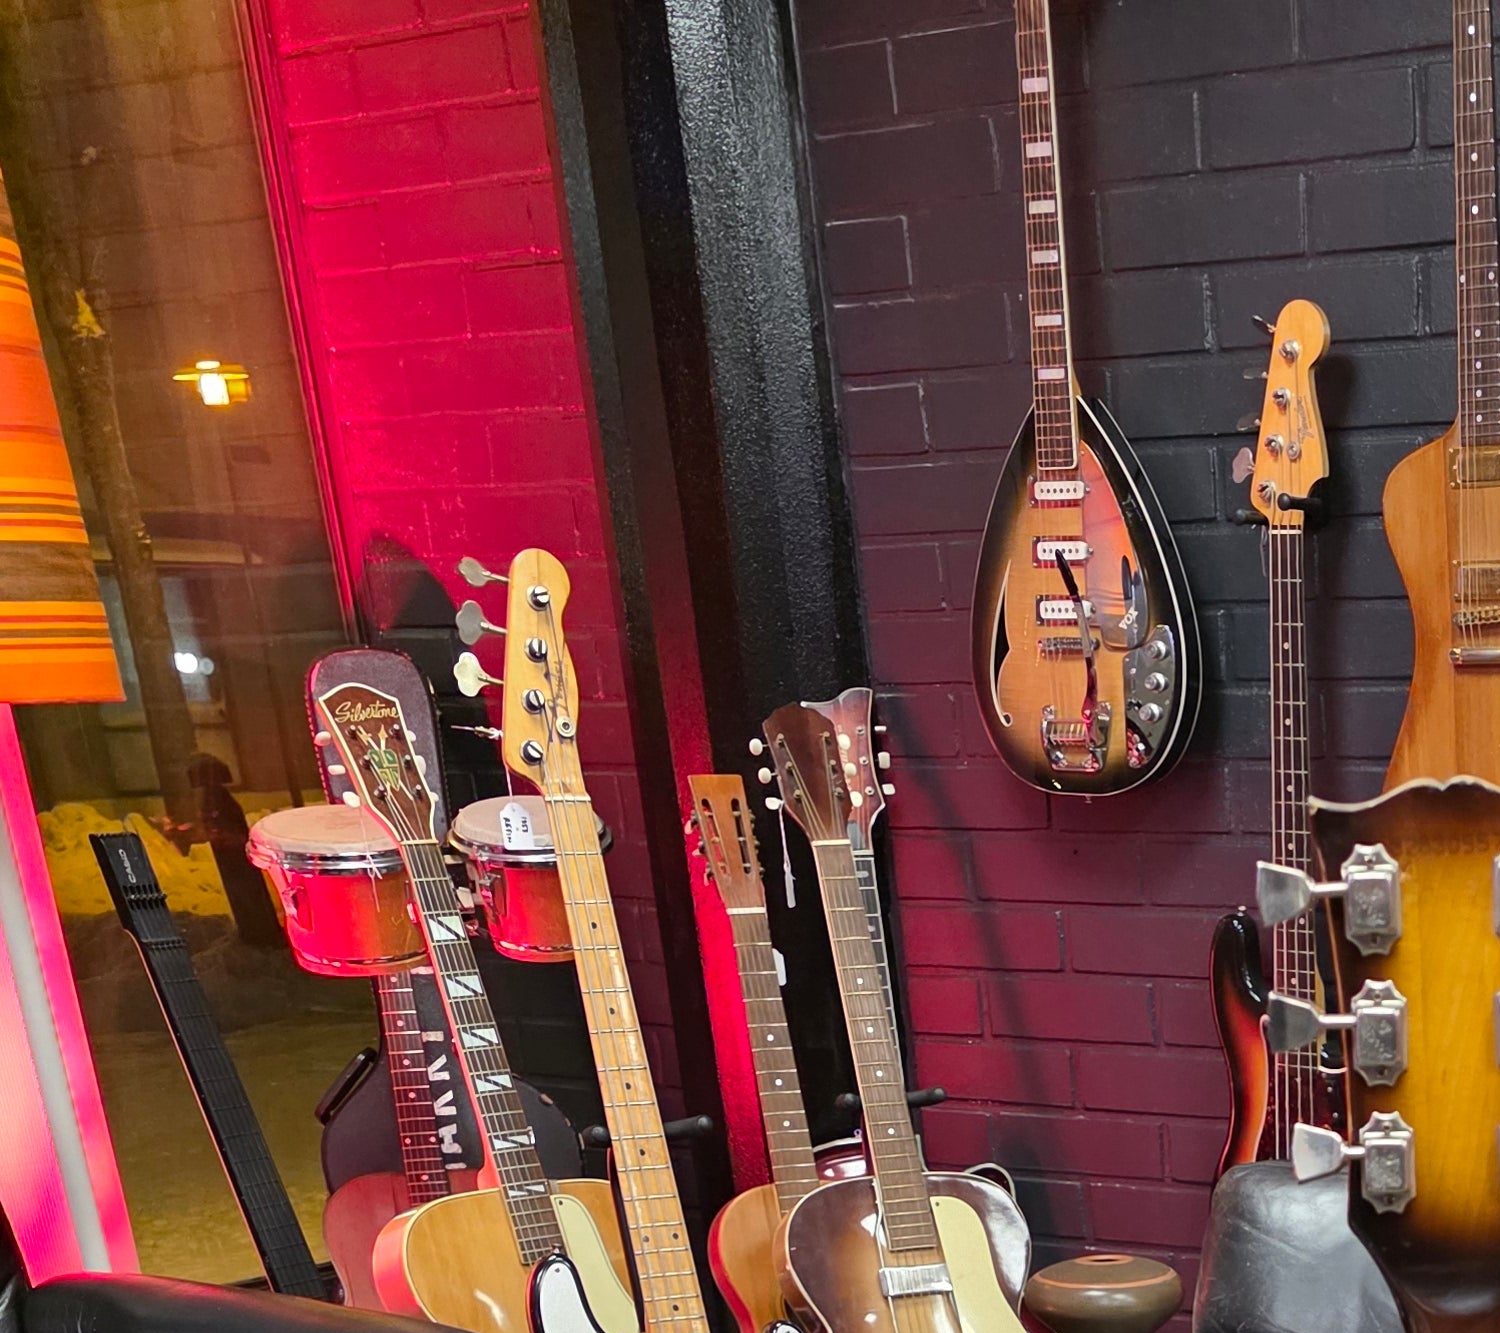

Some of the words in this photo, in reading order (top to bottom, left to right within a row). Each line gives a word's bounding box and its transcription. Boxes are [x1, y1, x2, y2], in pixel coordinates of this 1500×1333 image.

[1118, 606, 1138, 630] VOX
[335, 700, 399, 723] Silvertone
[119, 849, 136, 883] CASIO
